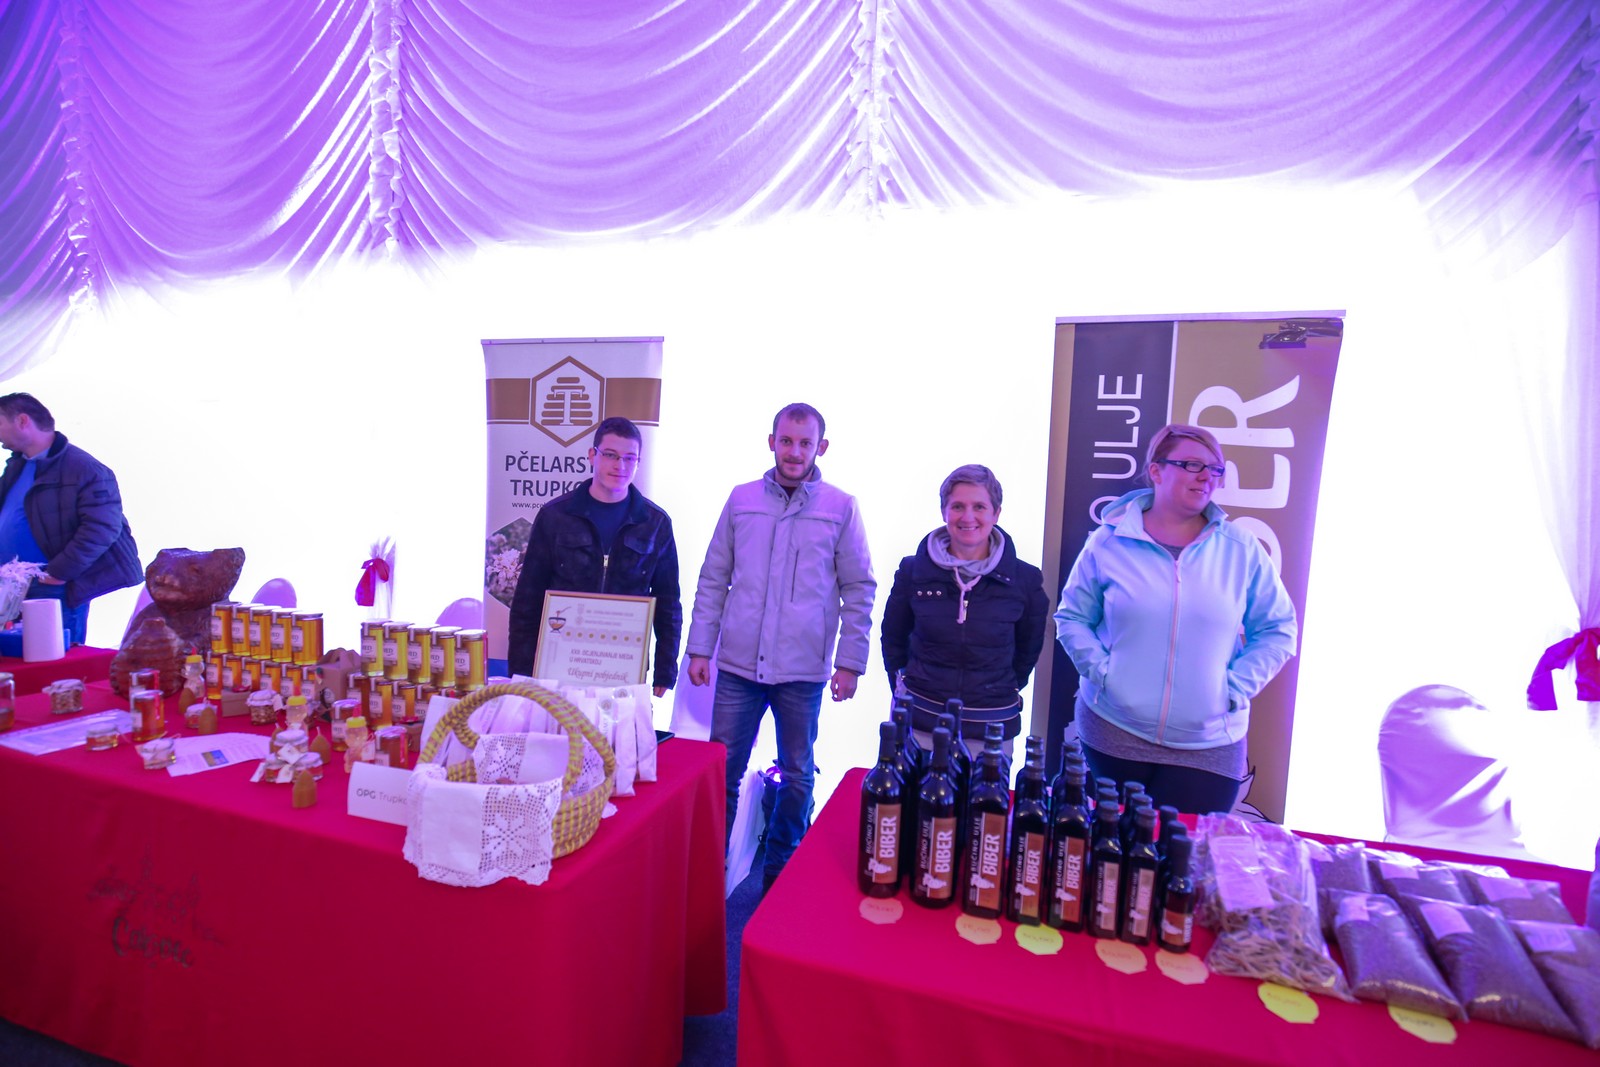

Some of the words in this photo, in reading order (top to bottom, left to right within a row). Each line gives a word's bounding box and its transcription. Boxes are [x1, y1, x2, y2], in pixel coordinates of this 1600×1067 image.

[1092, 374, 1143, 480] ULJE
[618, 653, 634, 661] MEDA
[593, 670, 630, 684] pobjednik
[356, 788, 376, 800] OPG
[879, 816, 897, 858] BIBER
[934, 829, 953, 873] BIBER
[982, 833, 1000, 876] BIBER
[1026, 850, 1041, 884] BIBER
[1066, 854, 1082, 890] BIBER
